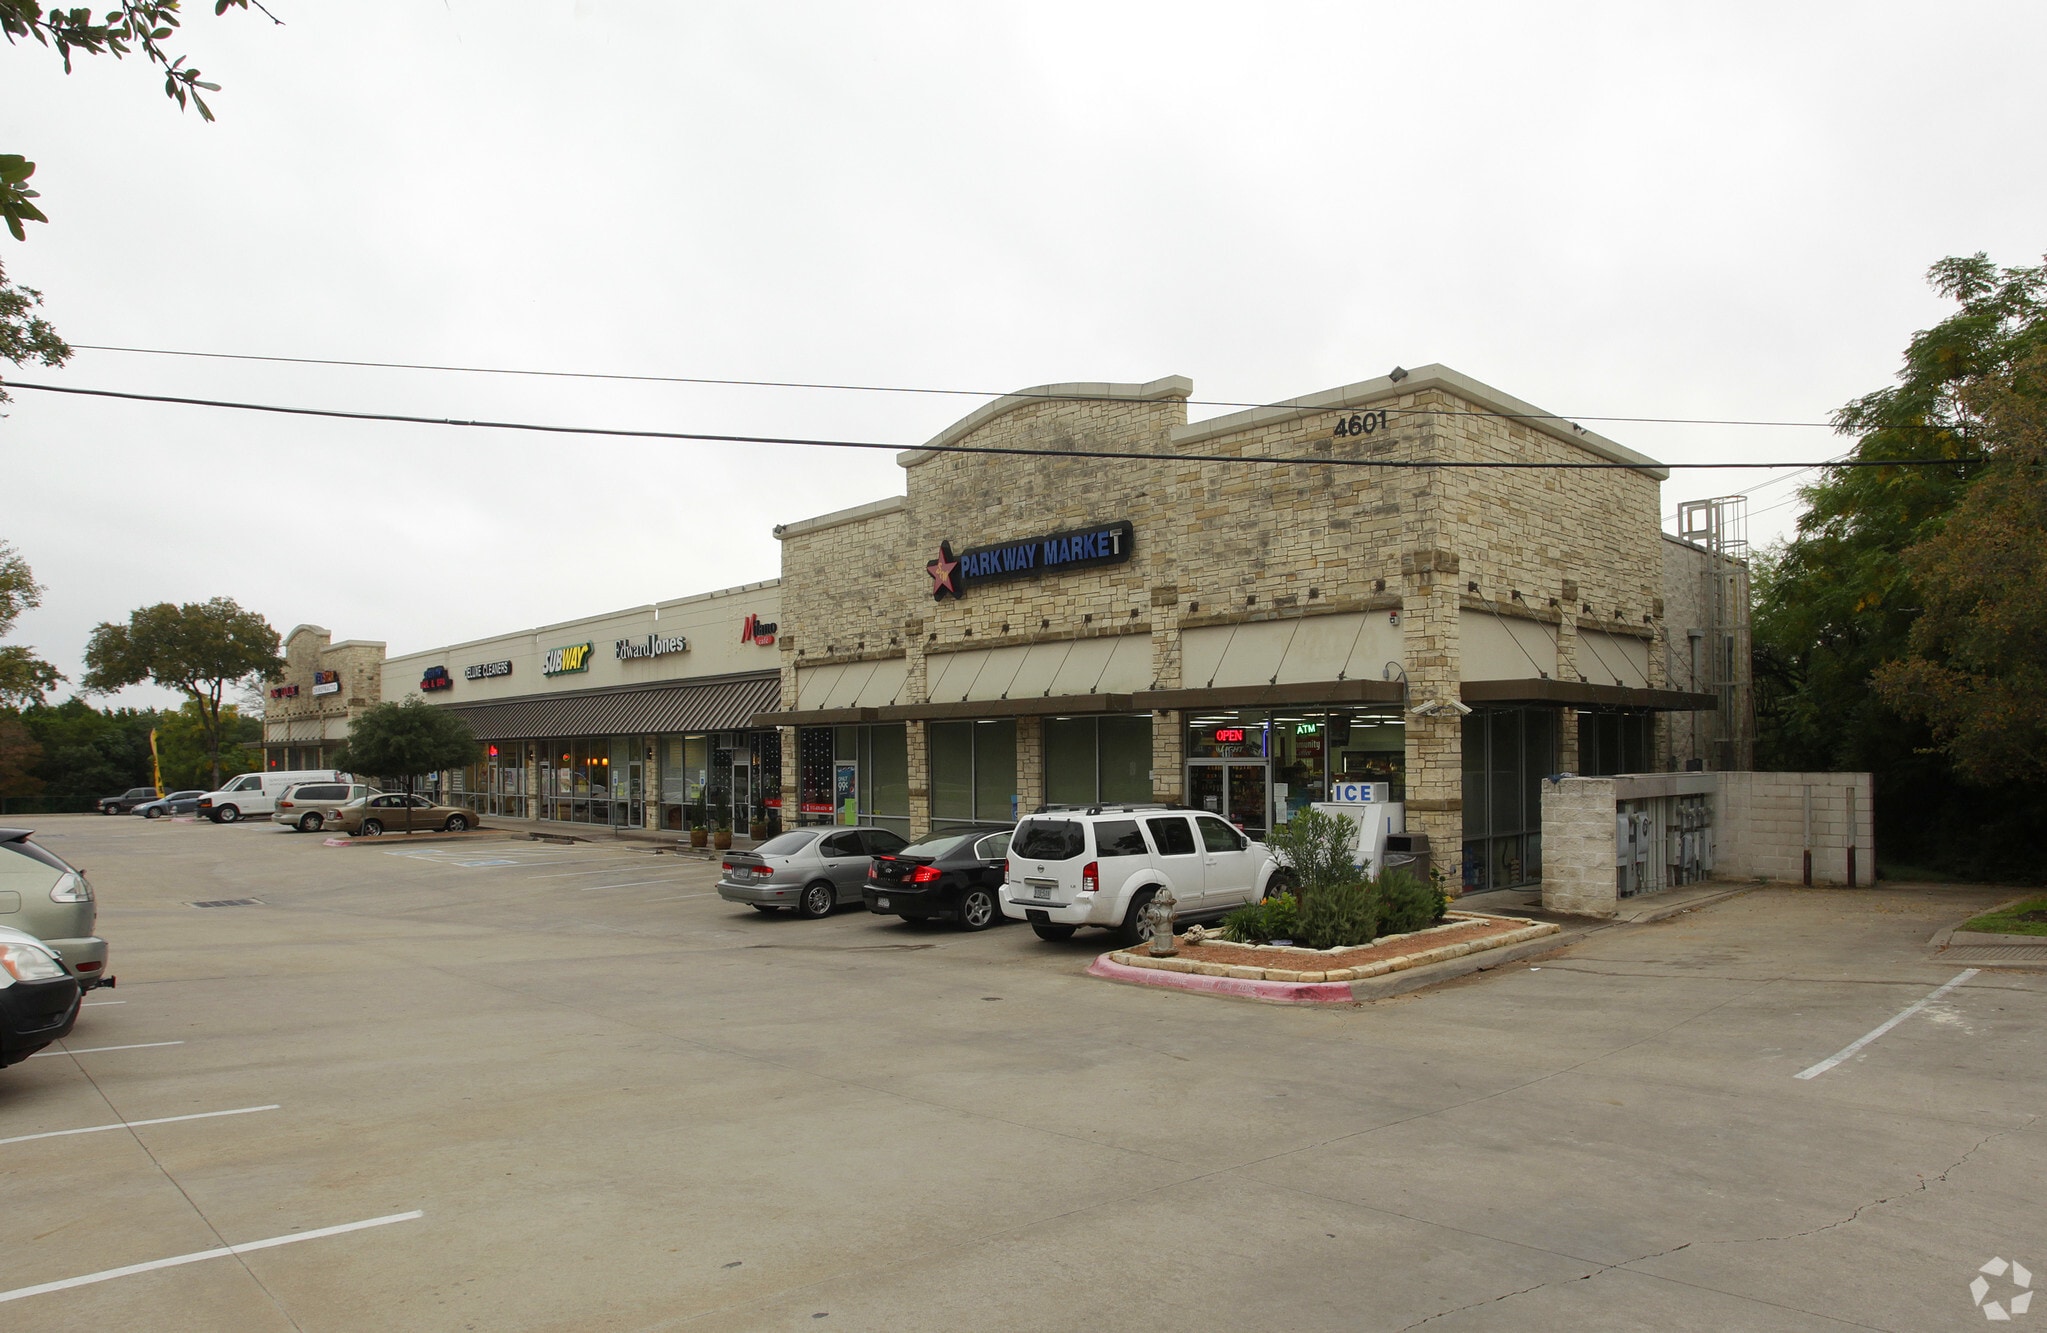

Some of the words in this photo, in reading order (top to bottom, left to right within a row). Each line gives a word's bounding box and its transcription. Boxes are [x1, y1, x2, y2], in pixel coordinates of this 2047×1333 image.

[1334, 409, 1387, 437] 4601
[960, 543, 1037, 579] PARKWAY
[1043, 527, 1123, 566] MARKET
[614, 639, 650, 660] Edward
[648, 634, 685, 658] Jones
[482, 661, 508, 677] CLEANERS
[542, 644, 589, 674] SUBWAY
[1216, 729, 1243, 742] OPEN
[1296, 724, 1316, 735] ATM
[1336, 785, 1371, 801] ICE
